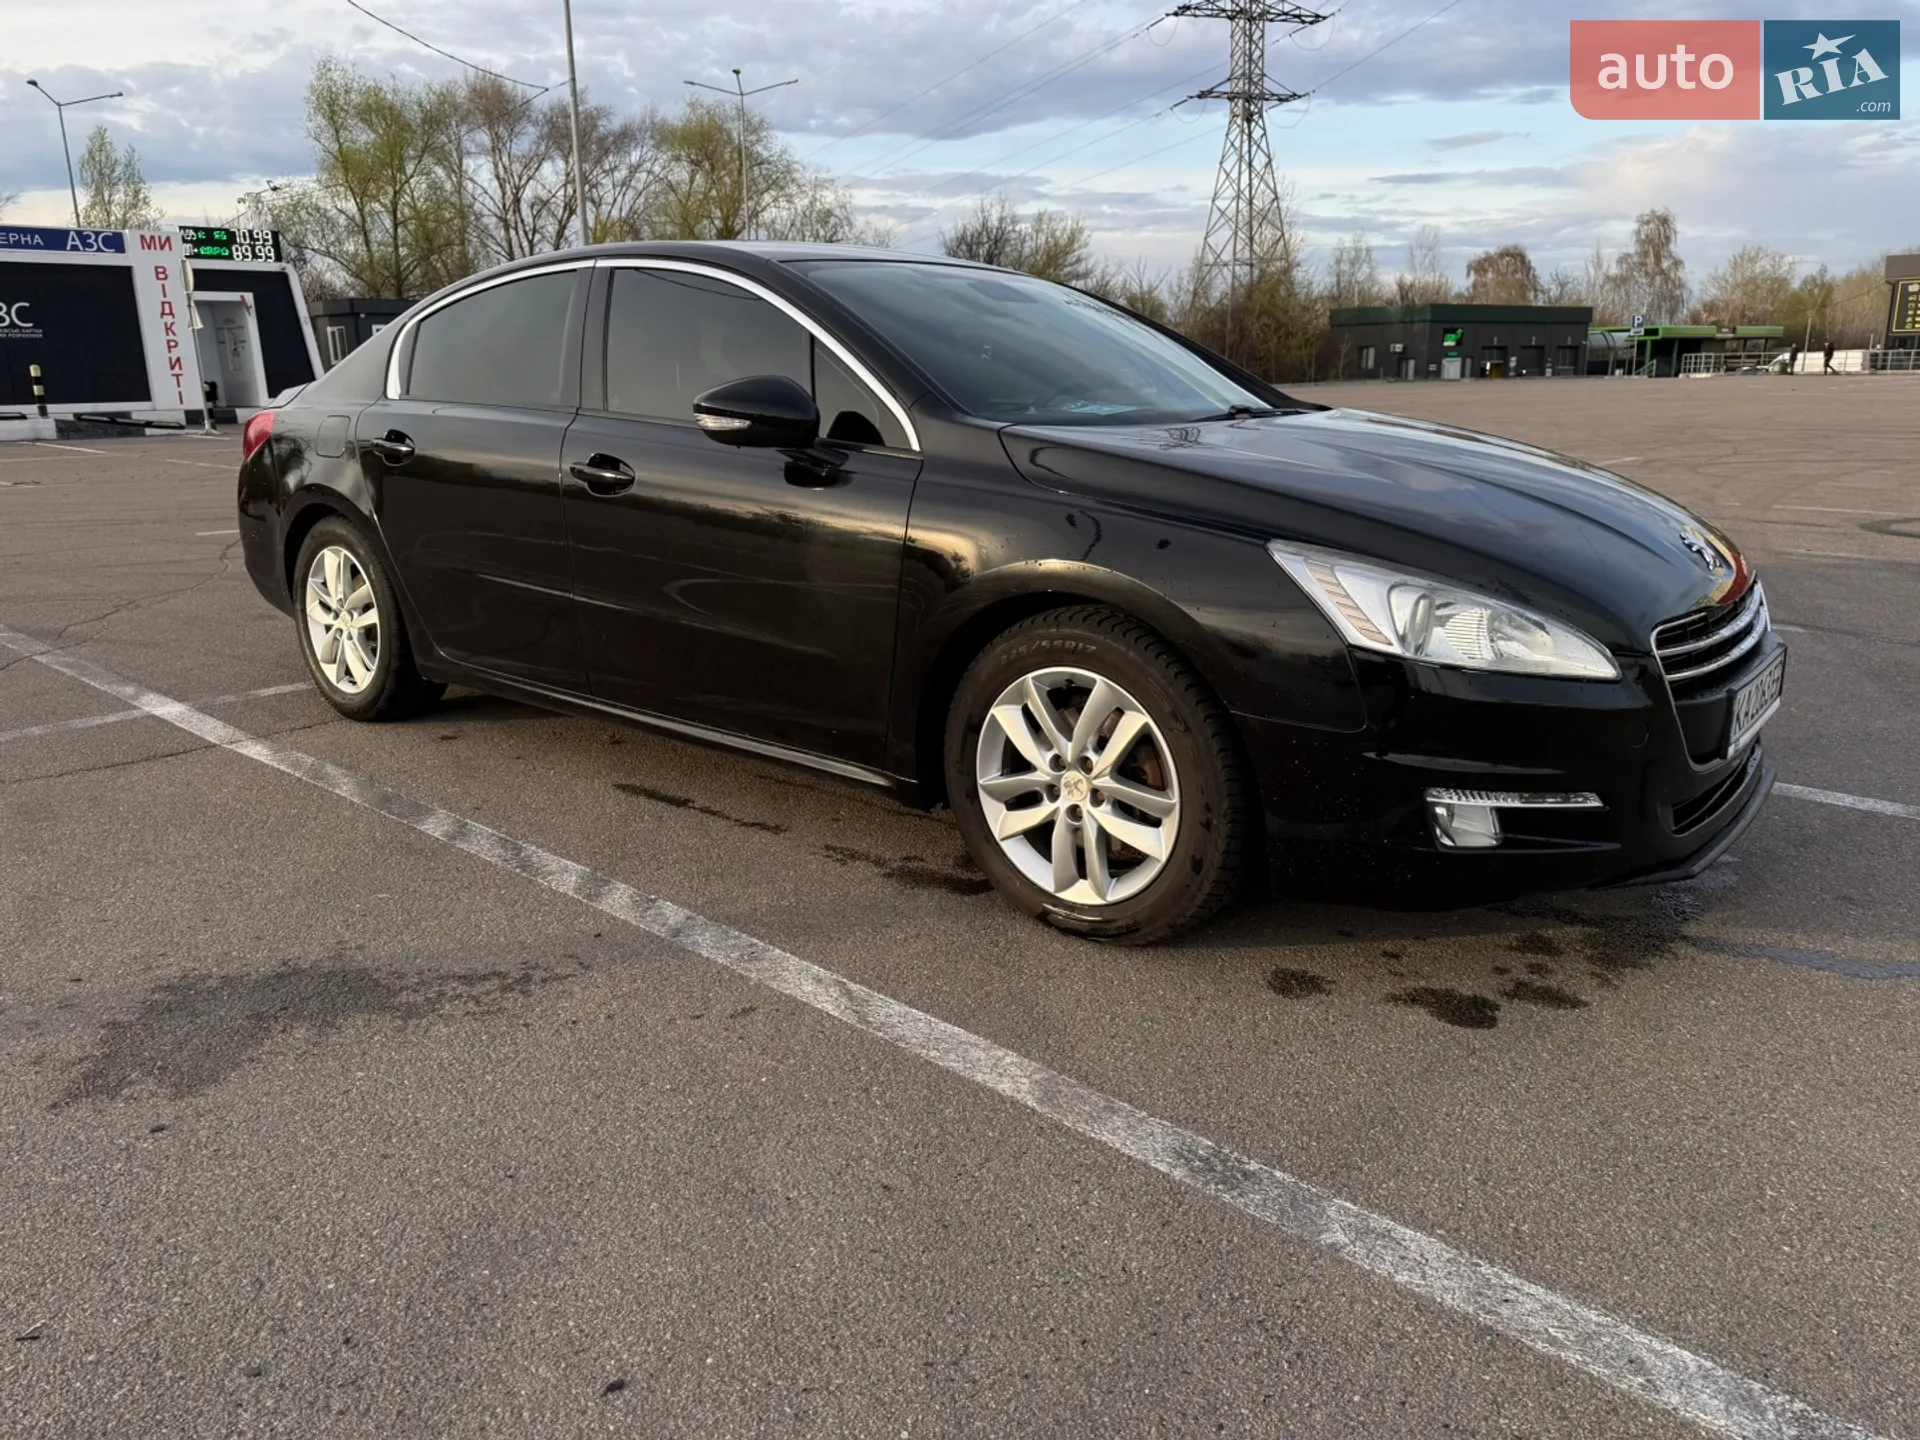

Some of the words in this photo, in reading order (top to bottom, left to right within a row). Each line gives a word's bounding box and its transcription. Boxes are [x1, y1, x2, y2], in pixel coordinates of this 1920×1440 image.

[66, 230, 116, 252] АЗС
[140, 234, 173, 252] МИ
[232, 244, 275, 262] 89.99
[1634, 315, 1643, 326] P
